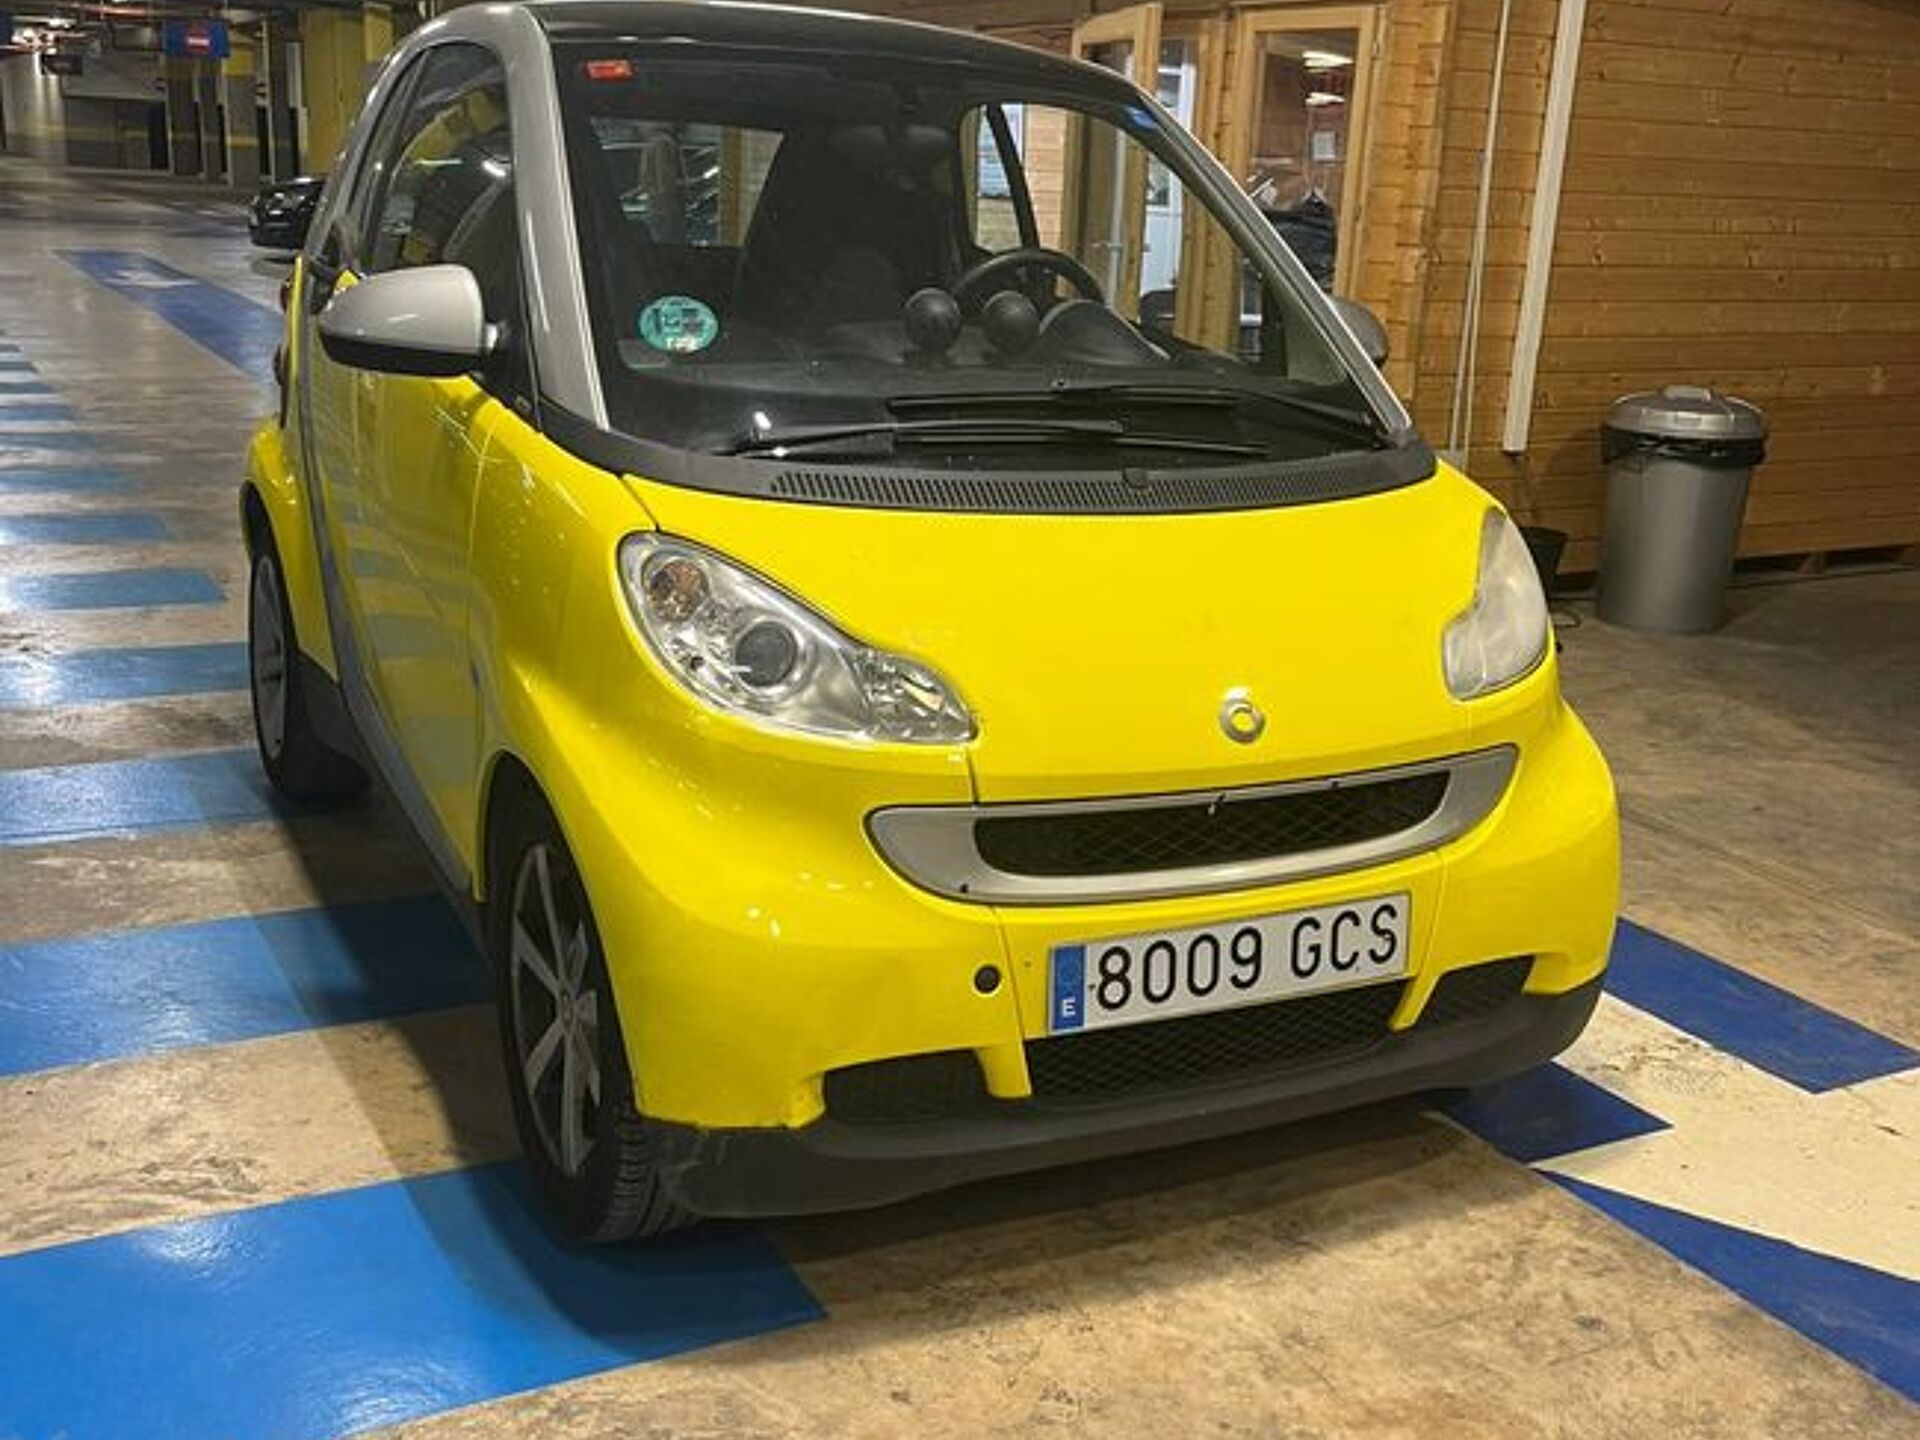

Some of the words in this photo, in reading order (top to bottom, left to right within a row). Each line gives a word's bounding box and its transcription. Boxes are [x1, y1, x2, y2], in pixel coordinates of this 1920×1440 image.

[1097, 925, 1263, 1010] 8009
[1290, 903, 1398, 978] GCS
[1062, 997, 1076, 1017] E
